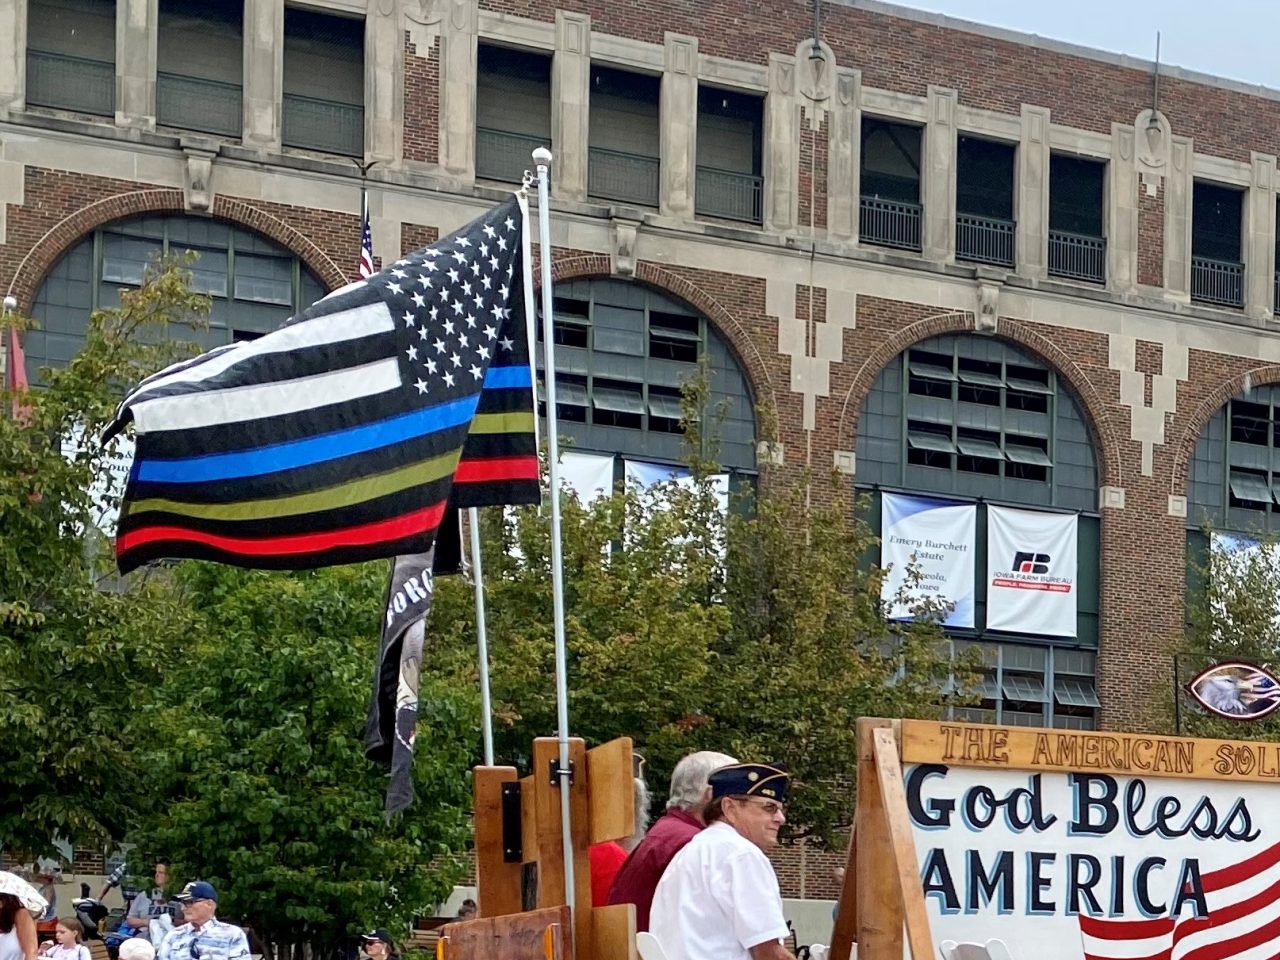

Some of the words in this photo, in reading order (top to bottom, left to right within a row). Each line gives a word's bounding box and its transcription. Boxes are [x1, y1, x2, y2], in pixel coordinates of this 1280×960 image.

[889, 535, 922, 548] Emery
[925, 539, 968, 552] Burchett
[993, 571, 1015, 580] IOWA
[1016, 573, 1039, 582] FARM
[1040, 576, 1073, 584] BUREAU
[940, 725, 1009, 763] THE
[1031, 732, 1195, 774] AMERICAN
[903, 763, 1058, 833] God
[1066, 772, 1262, 842] Bless
[922, 848, 1210, 921] AMERICA
